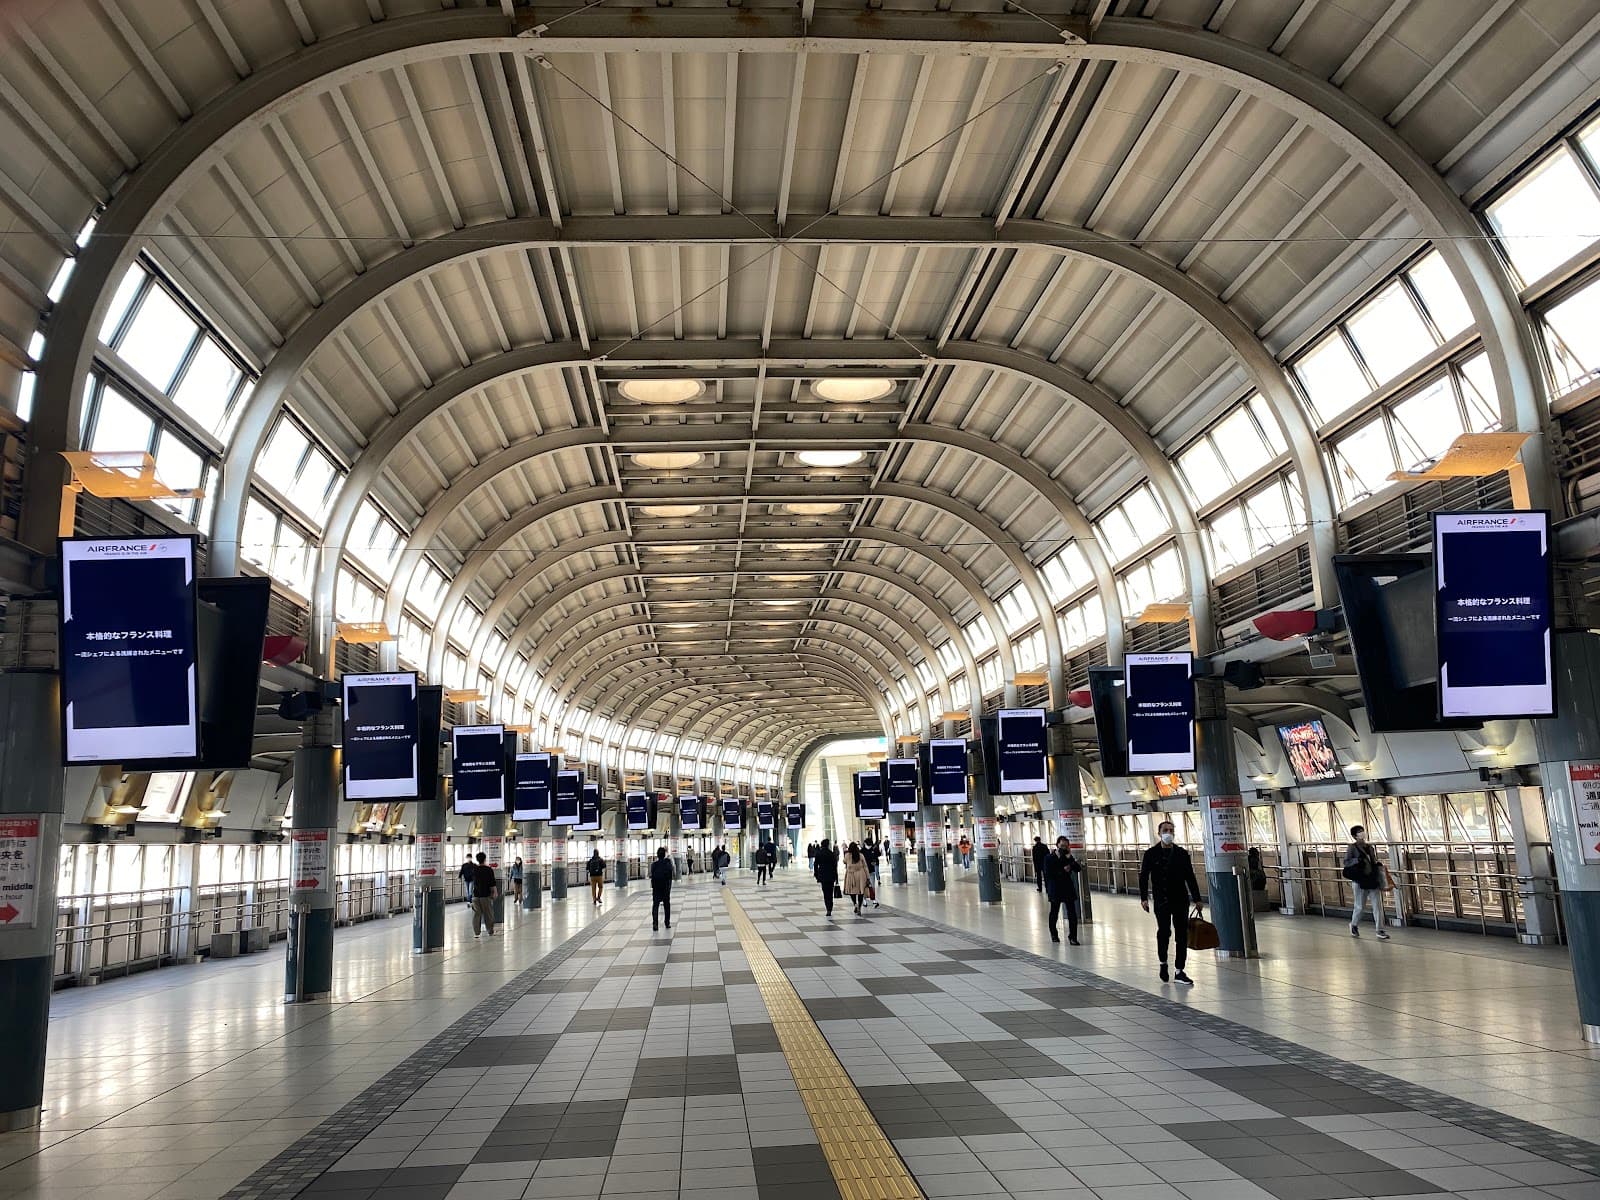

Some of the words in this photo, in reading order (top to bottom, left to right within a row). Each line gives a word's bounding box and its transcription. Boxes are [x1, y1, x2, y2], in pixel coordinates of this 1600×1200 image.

[1457, 518, 1508, 526] AIRFRANCE
[87, 544, 148, 553] AIRFRANCE
[1579, 820, 1599, 828] walk
[2, 882, 33, 891] middle
